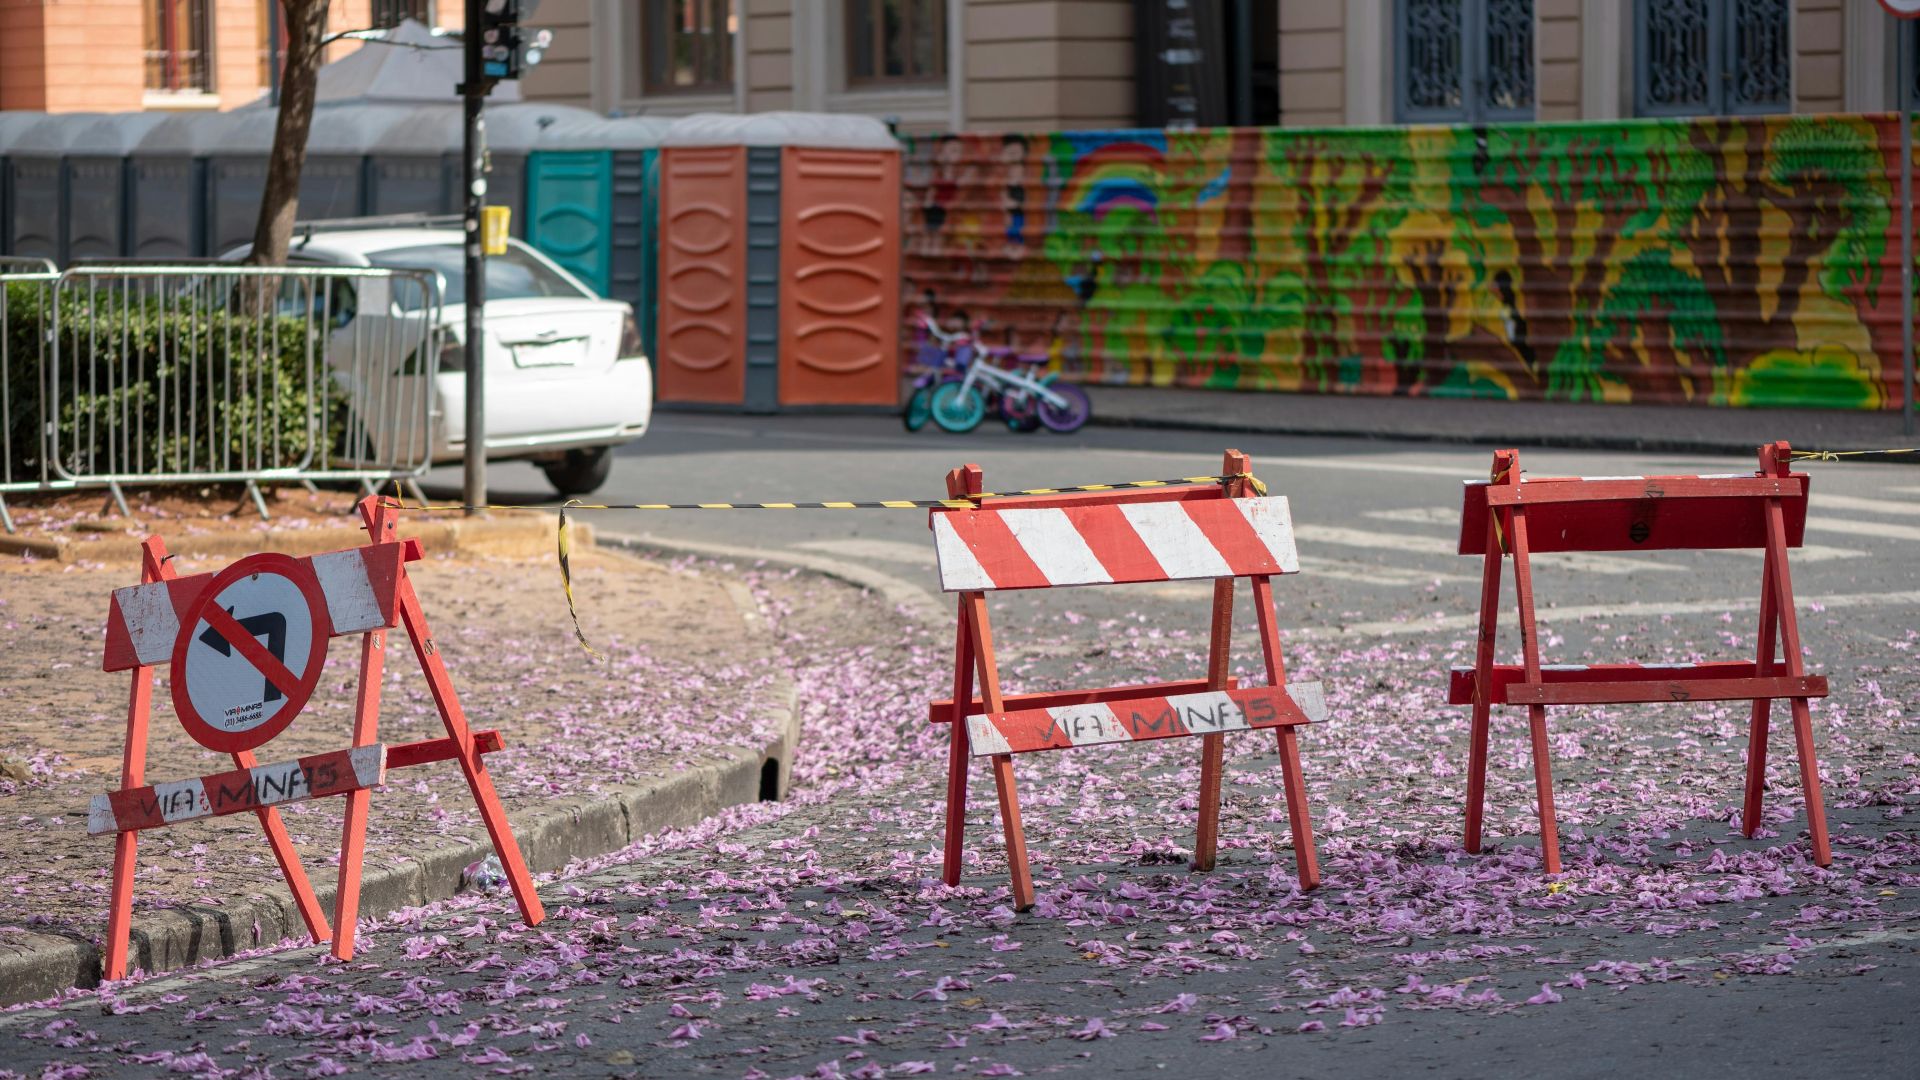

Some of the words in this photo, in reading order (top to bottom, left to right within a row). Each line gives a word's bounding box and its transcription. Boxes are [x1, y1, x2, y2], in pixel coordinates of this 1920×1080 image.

[1037, 714, 1103, 742] VIA
[1132, 697, 1278, 735] MINAS
[139, 788, 194, 817] VIA
[216, 761, 339, 808] MINAS
